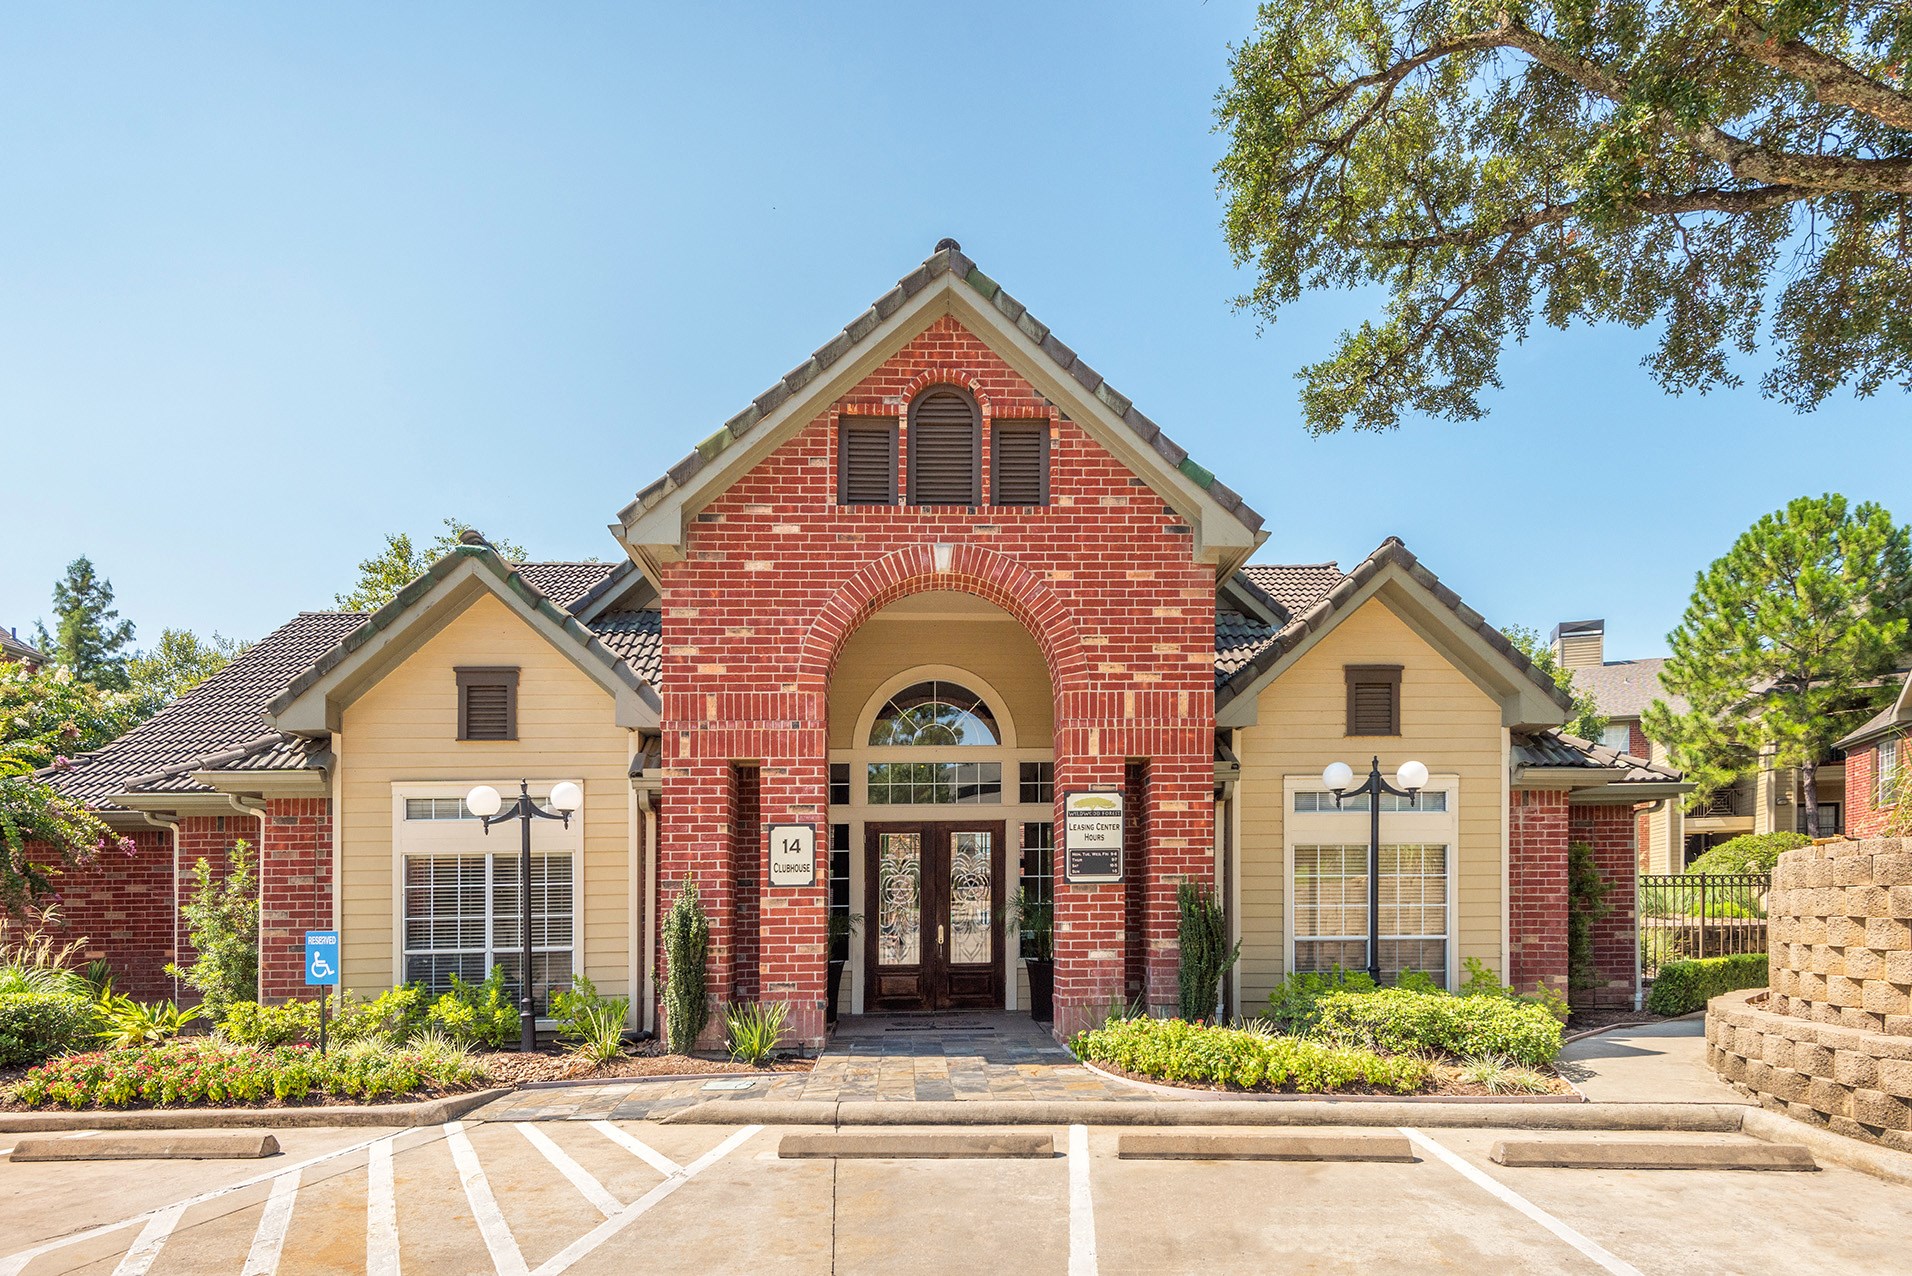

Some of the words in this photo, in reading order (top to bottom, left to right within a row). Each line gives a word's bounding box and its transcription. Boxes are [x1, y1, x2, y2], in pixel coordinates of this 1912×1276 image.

[1069, 823, 1095, 831] LEASING
[1096, 822, 1120, 830] CENTER
[1084, 833, 1105, 841] HOURS
[782, 839, 801, 853] 14
[773, 862, 811, 873] CLUBHOUSE
[308, 936, 337, 945] RESERVED
